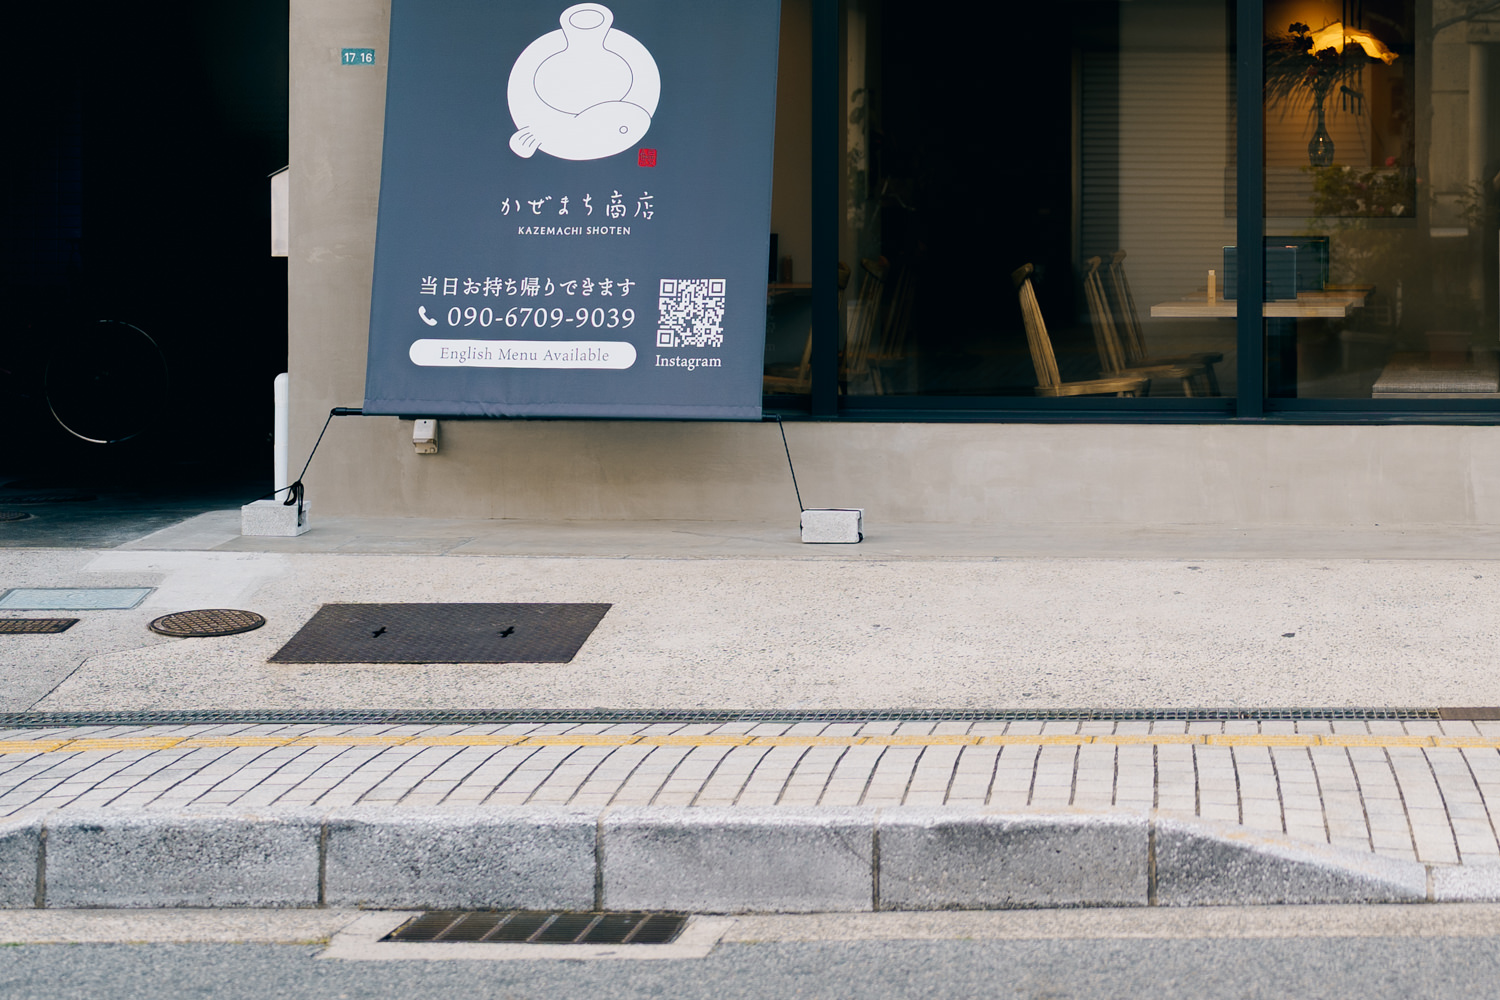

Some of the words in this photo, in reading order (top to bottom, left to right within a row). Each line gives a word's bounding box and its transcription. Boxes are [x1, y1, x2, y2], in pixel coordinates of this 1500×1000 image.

[344, 52, 356, 63] 17
[360, 52, 373, 63] 16
[501, 190, 656, 220] かぜまち商店
[517, 226, 583, 236] KAZEMACHI
[586, 226, 632, 236] SHOTEN
[419, 275, 636, 298] 当日お持ち帰りできます
[447, 306, 636, 330] 090-6709-9039
[440, 347, 492, 363] English
[498, 348, 538, 361] Menu
[543, 348, 610, 362] Available
[655, 354, 722, 371] Instagram
